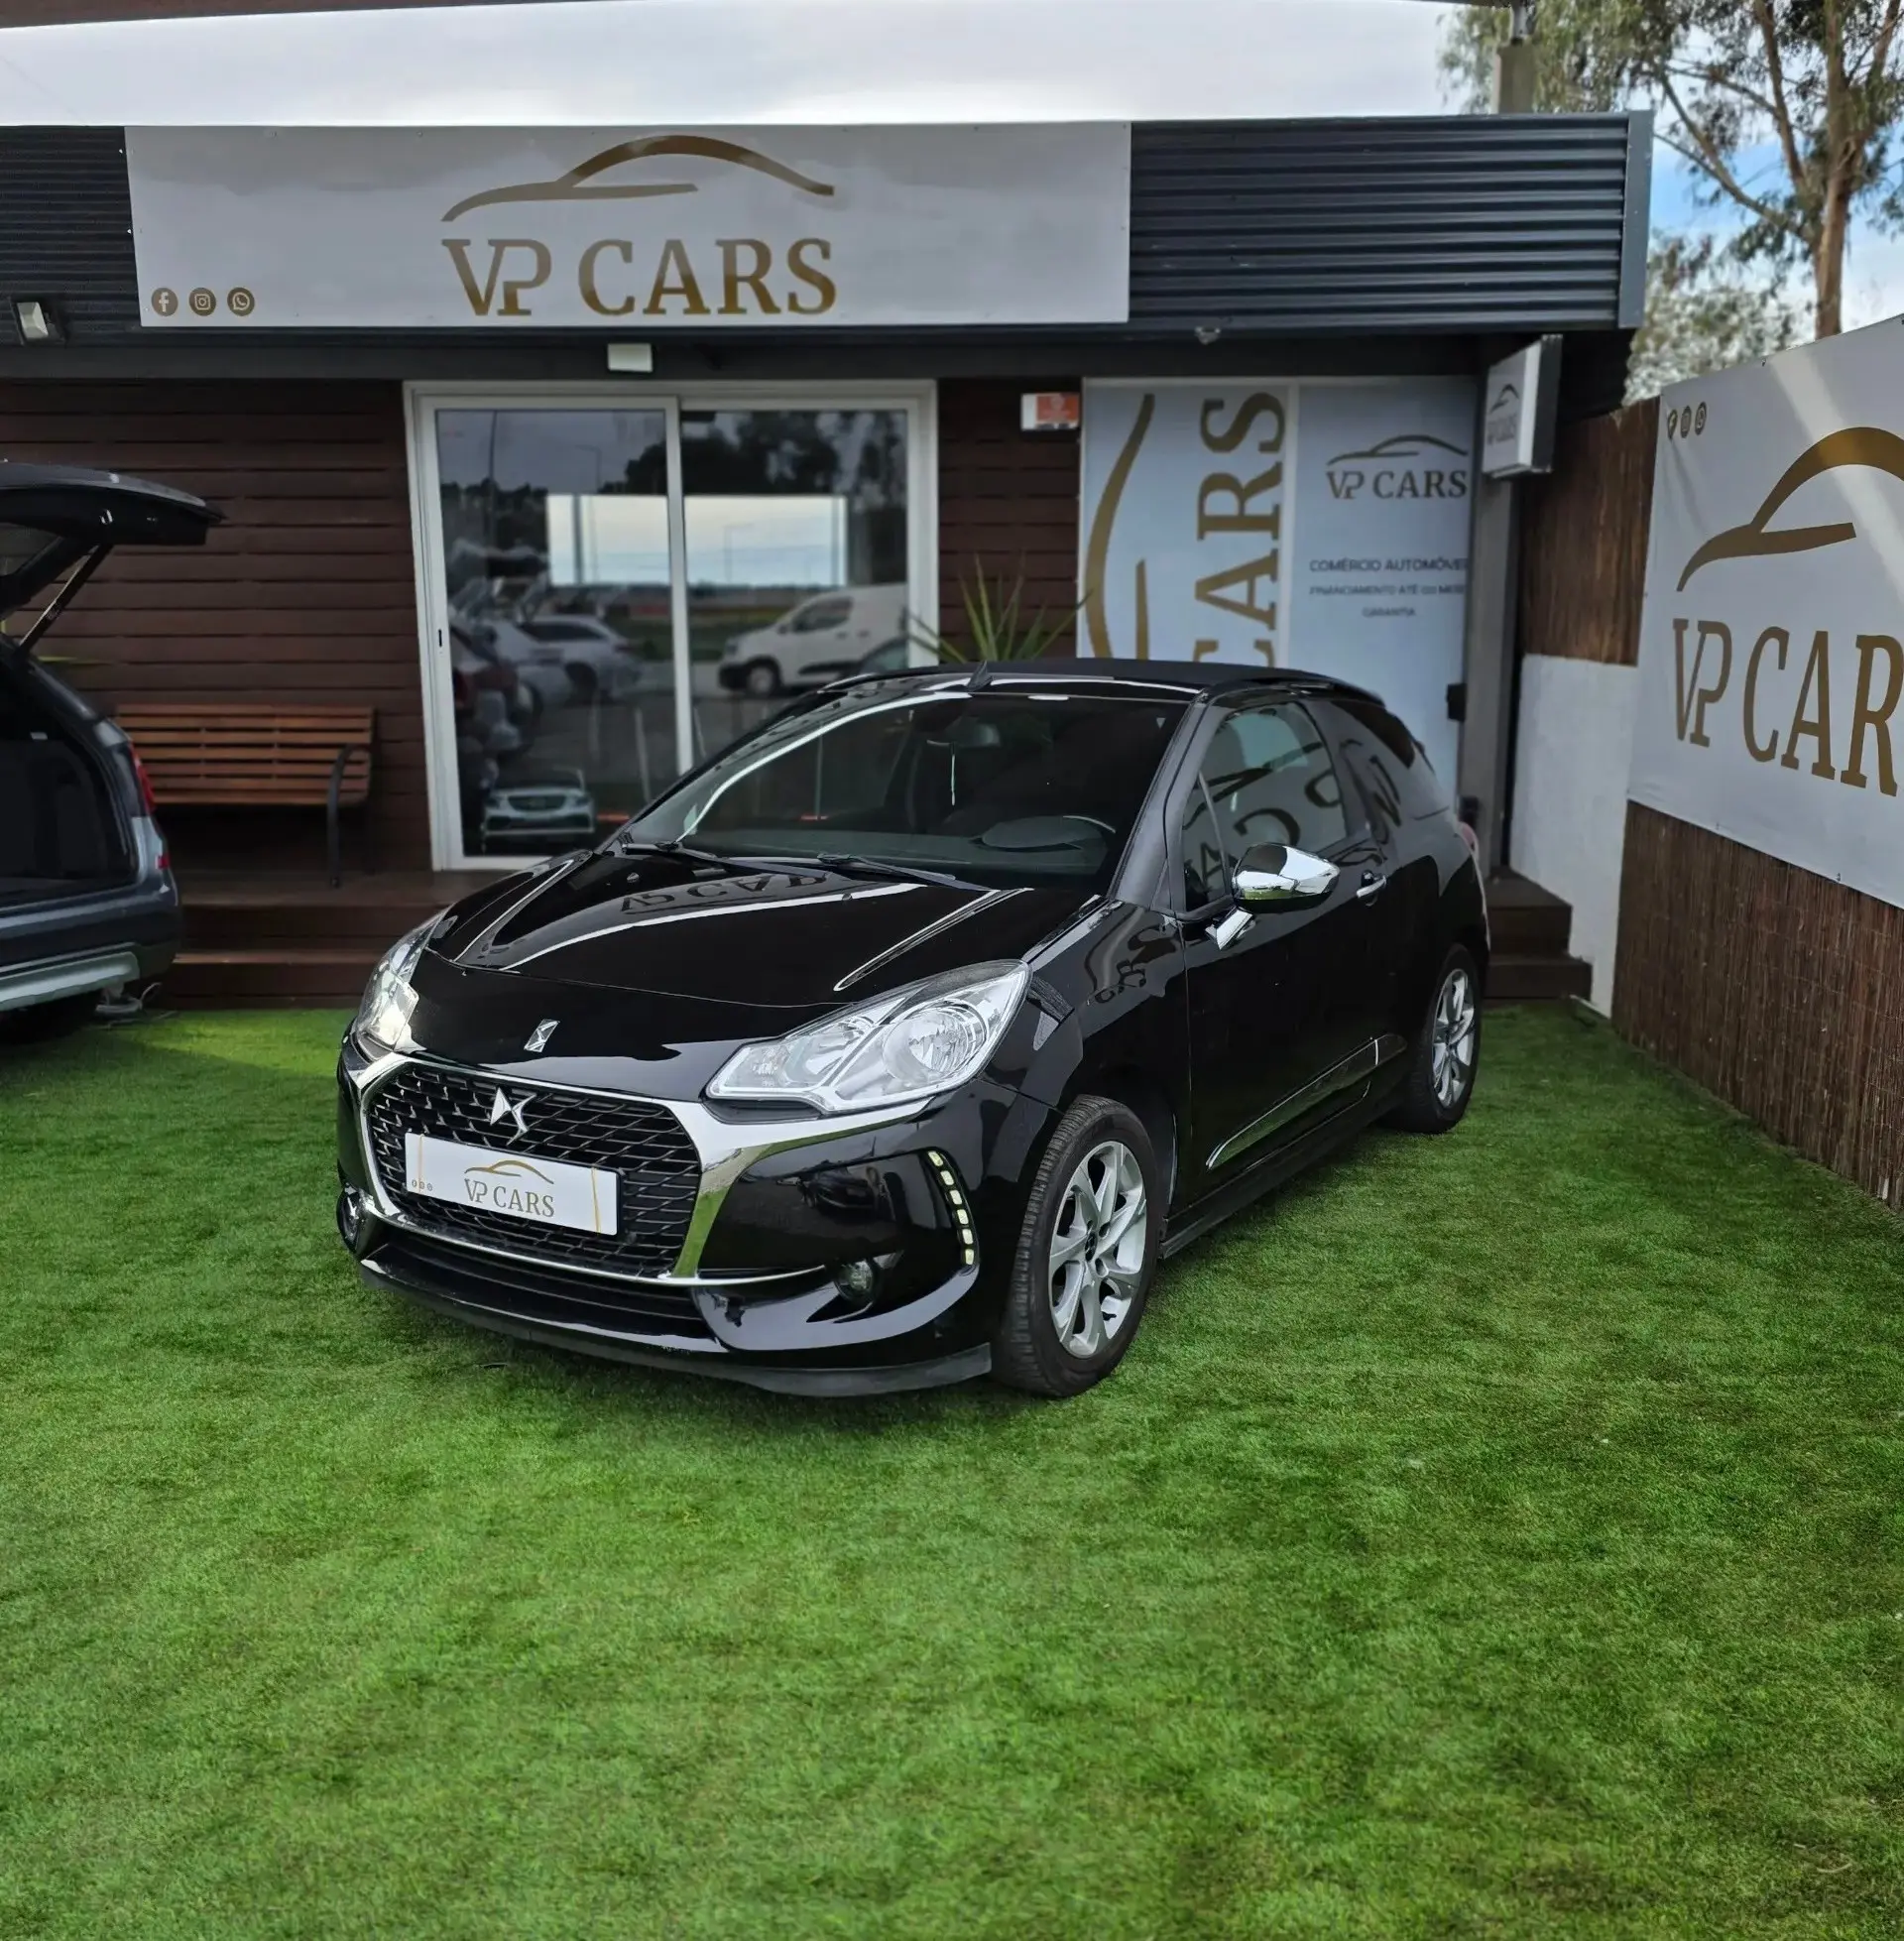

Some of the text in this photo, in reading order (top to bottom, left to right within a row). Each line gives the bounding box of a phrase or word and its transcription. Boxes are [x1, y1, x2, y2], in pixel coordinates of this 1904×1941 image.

[440, 237, 837, 316] VP CARS
[1326, 470, 1468, 499] VP CARS
[1309, 556, 1381, 571] COMÉRCIO
[1673, 617, 1904, 797] VP CAR
[464, 1178, 555, 1218] VP CARS
